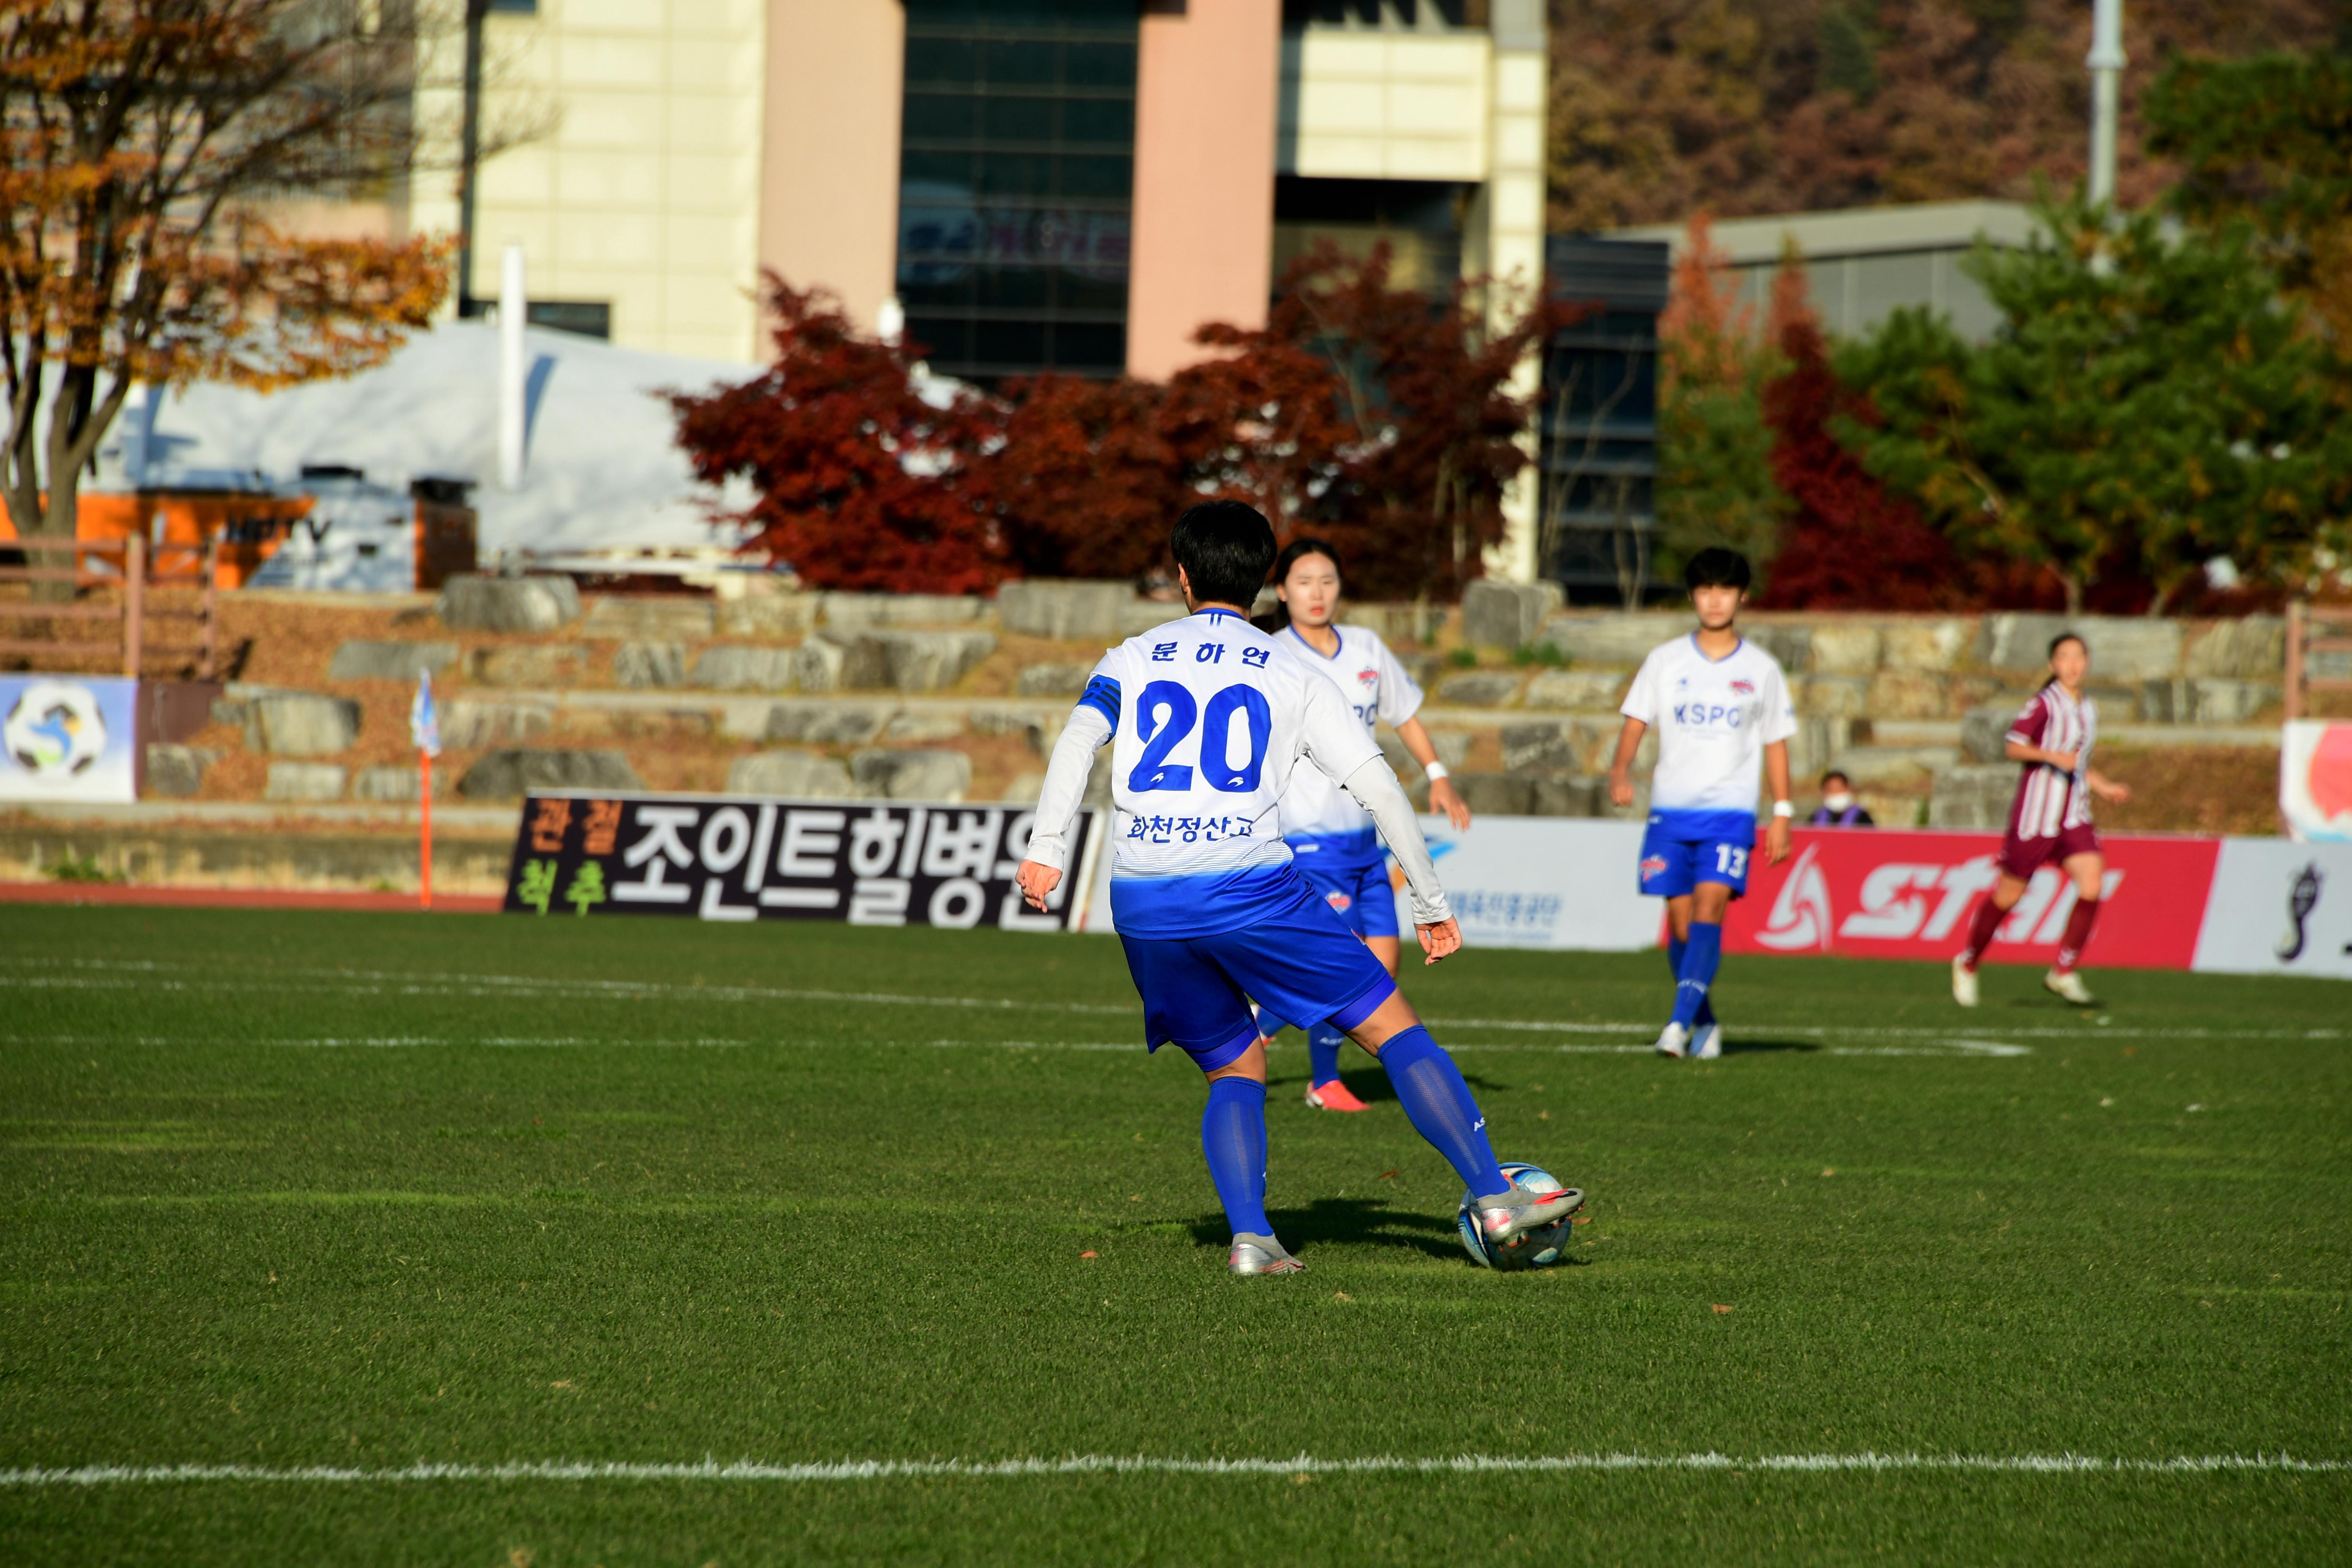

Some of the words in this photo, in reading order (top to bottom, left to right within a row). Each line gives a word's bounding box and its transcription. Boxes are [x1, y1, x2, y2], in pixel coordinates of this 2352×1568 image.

[1128, 680, 1271, 793] 20
[1127, 815, 1253, 844] 화천정산고
[1716, 843, 1748, 879] 13
